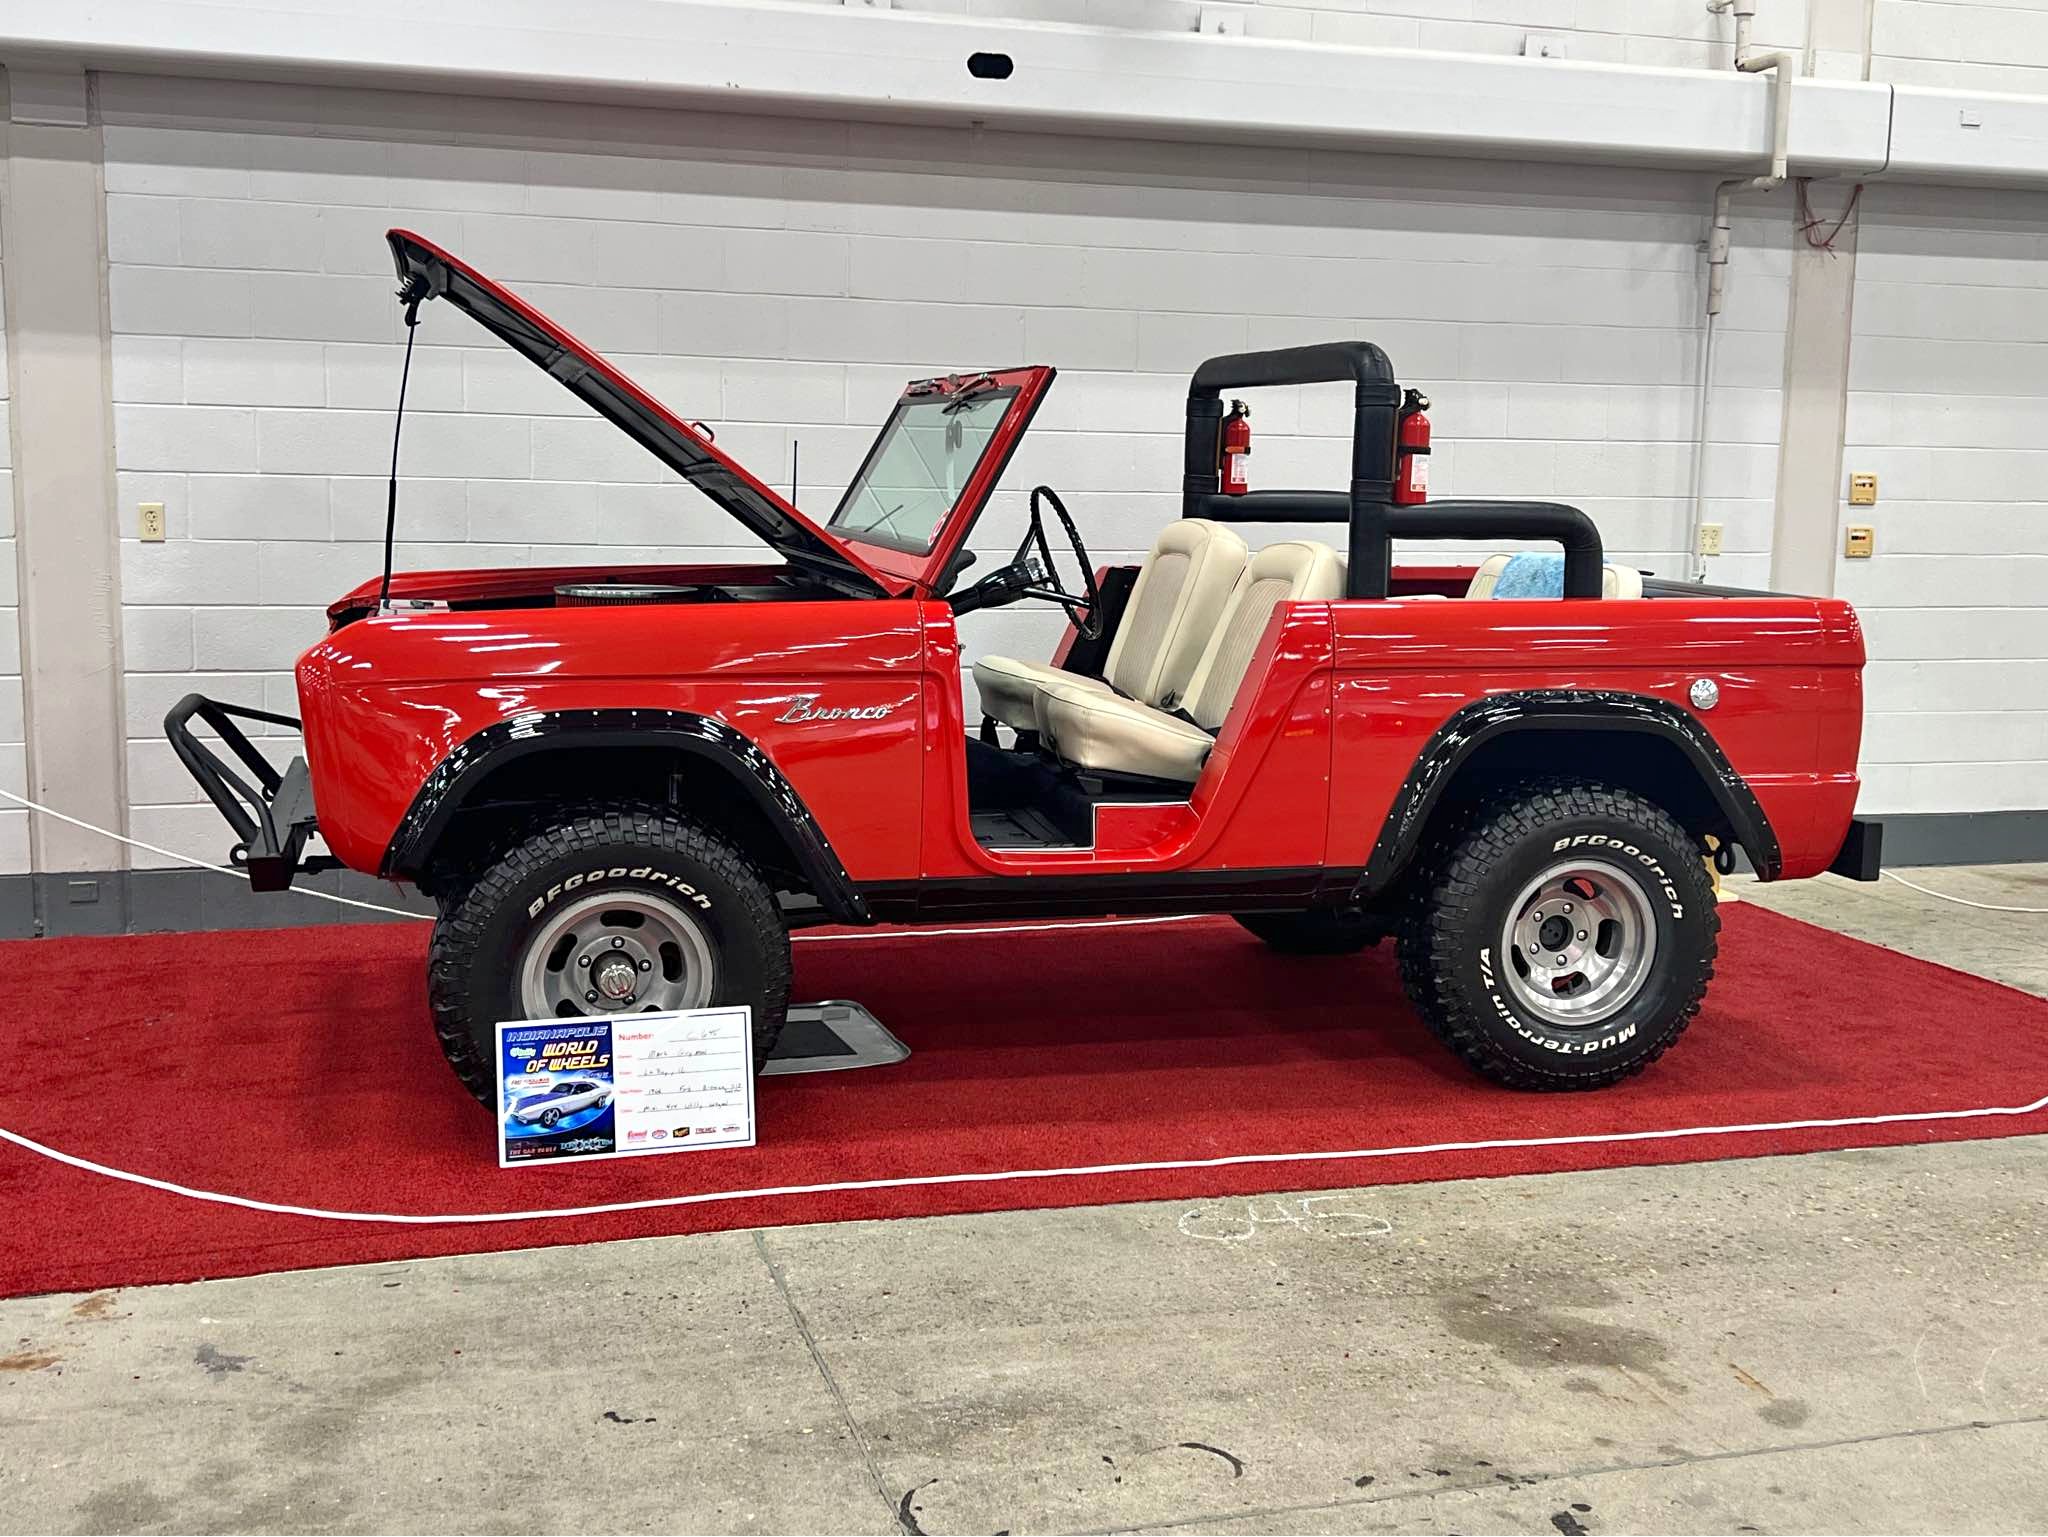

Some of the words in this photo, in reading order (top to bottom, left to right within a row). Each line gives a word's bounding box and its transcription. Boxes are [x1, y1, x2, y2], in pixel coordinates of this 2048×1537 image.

[774, 695, 890, 723] Bronco
[1552, 834, 1685, 920] BFGoodrich
[527, 865, 712, 919] BFGoodrich
[1479, 946, 1495, 991] T/A
[506, 1025, 609, 1043] INDIANAPOLIS
[618, 1032, 654, 1041] Number:
[1491, 994, 1638, 1056] Mud-Terrain
[542, 1039, 599, 1057] WORLD
[525, 1058, 549, 1073] OF
[548, 1054, 610, 1071] WHEELS
